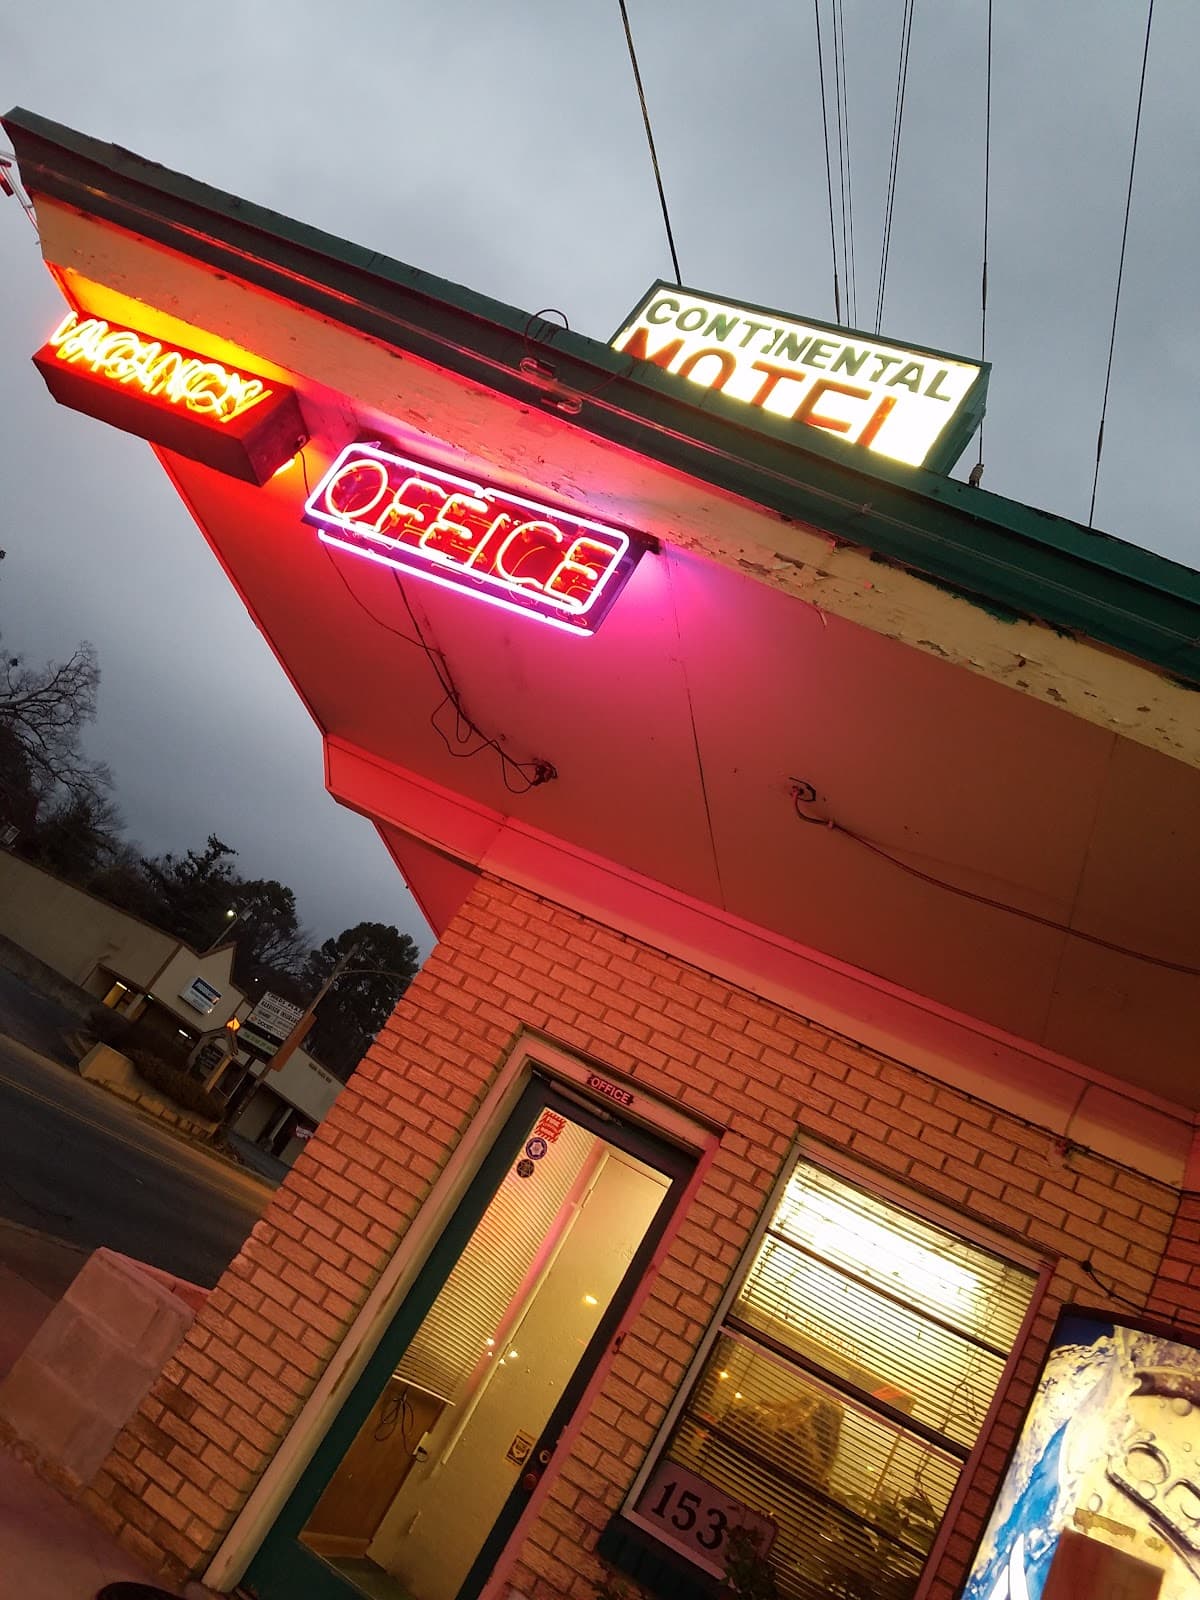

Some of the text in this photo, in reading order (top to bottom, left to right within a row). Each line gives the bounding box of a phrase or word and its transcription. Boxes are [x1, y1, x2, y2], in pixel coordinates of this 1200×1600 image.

[49, 310, 273, 424] VACANCY
[645, 297, 952, 402] CONTINENTAL
[323, 458, 620, 610] OFFICE
[590, 1077, 631, 1105] OFFICE
